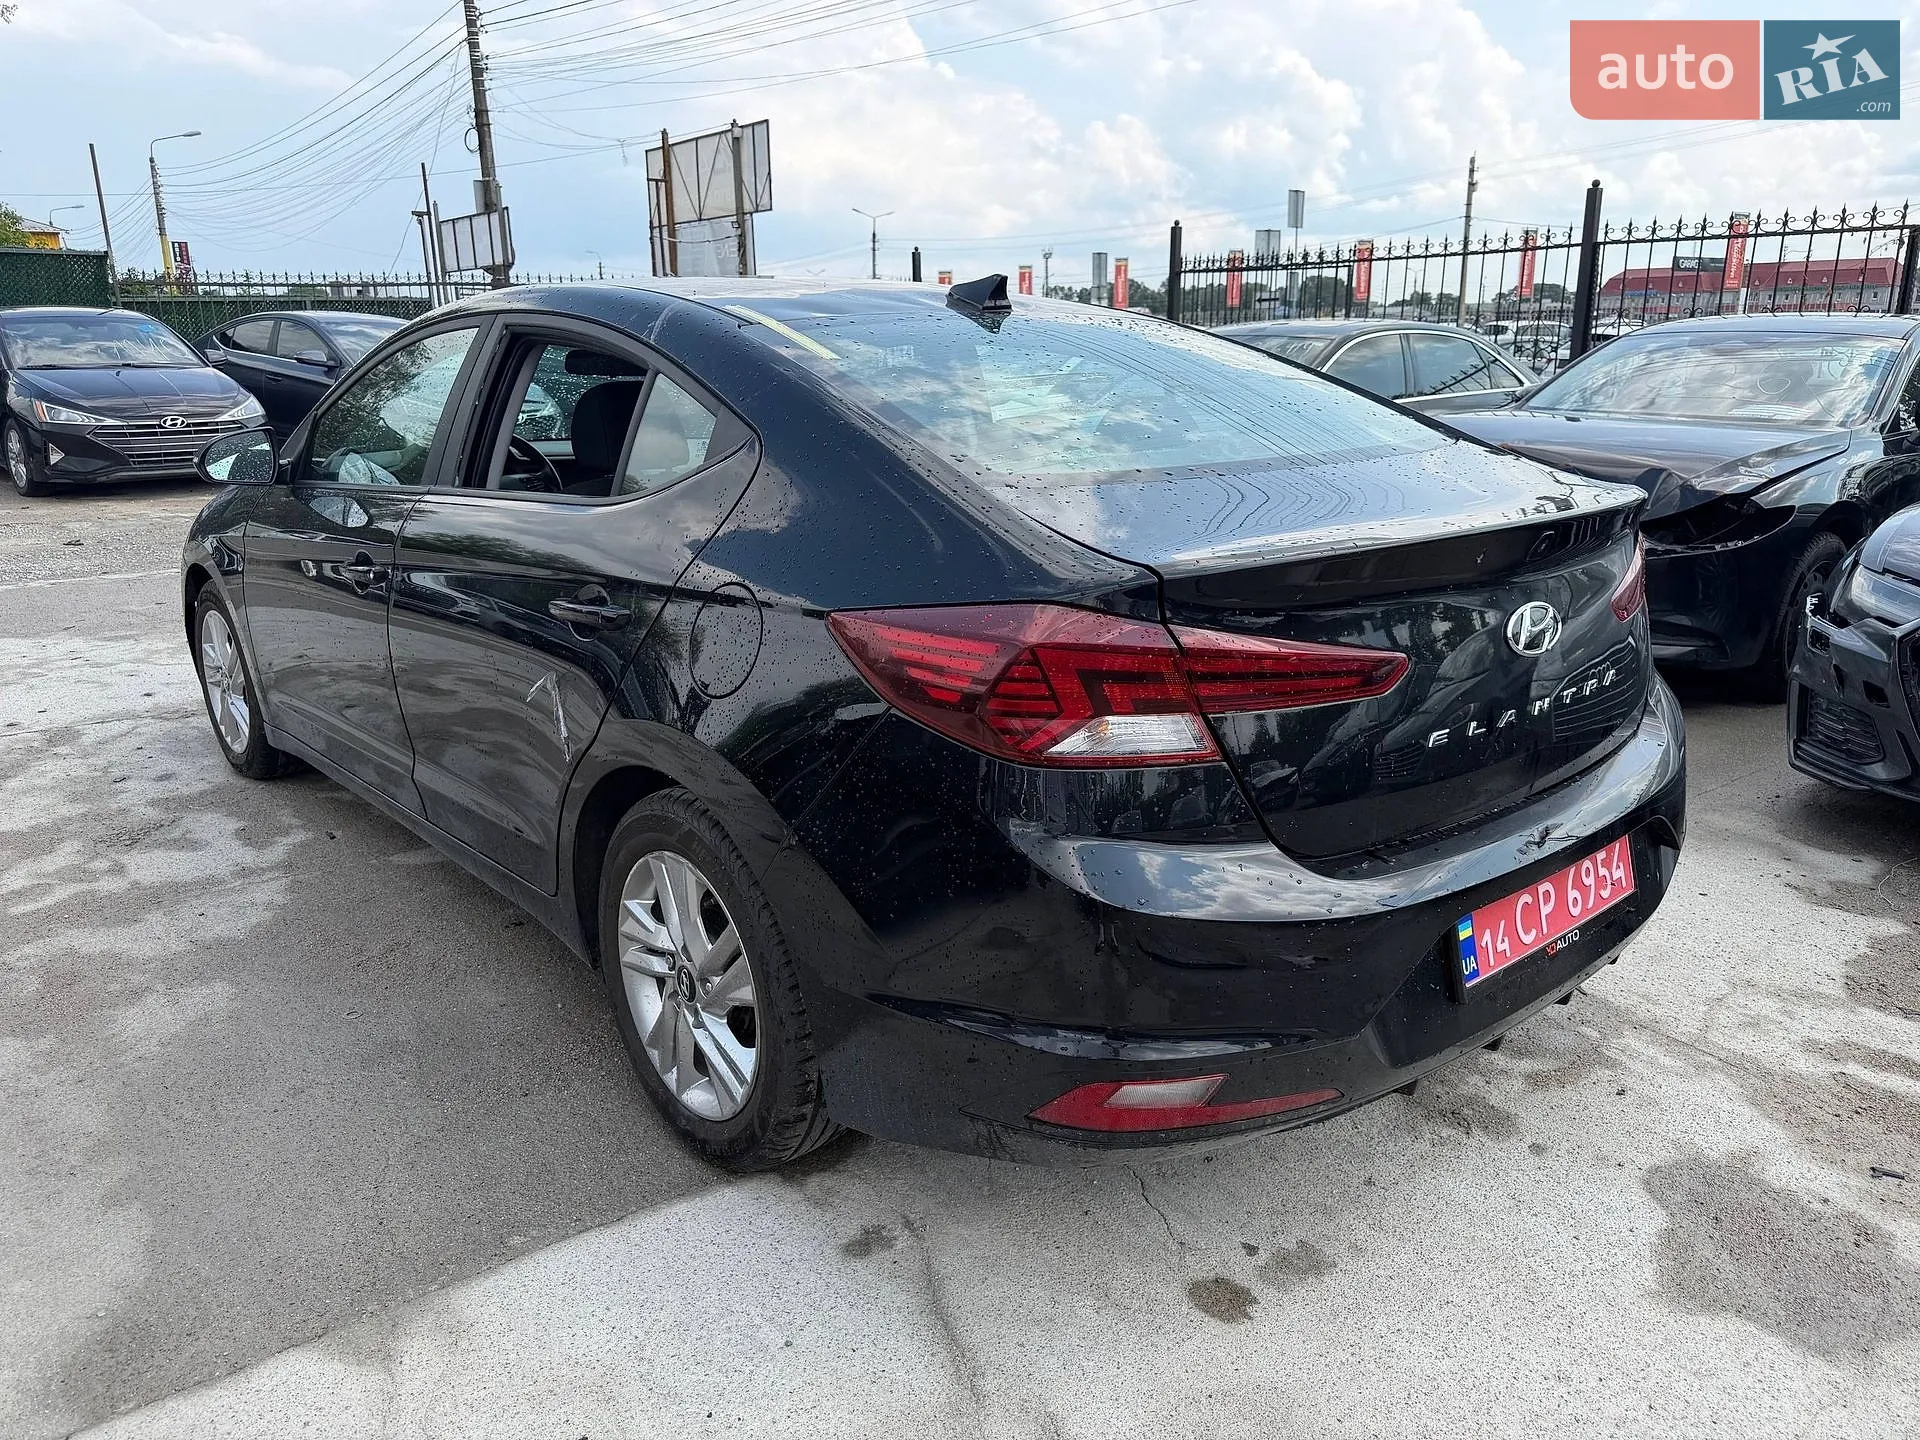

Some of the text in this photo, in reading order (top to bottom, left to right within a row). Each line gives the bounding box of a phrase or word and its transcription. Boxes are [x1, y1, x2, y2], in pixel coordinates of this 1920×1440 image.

[1679, 259, 1703, 269] GARAG
[1428, 670, 1616, 748] ELANTRA
[1481, 843, 1627, 967] 14 CP 6954
[1463, 955, 1478, 975] UA
